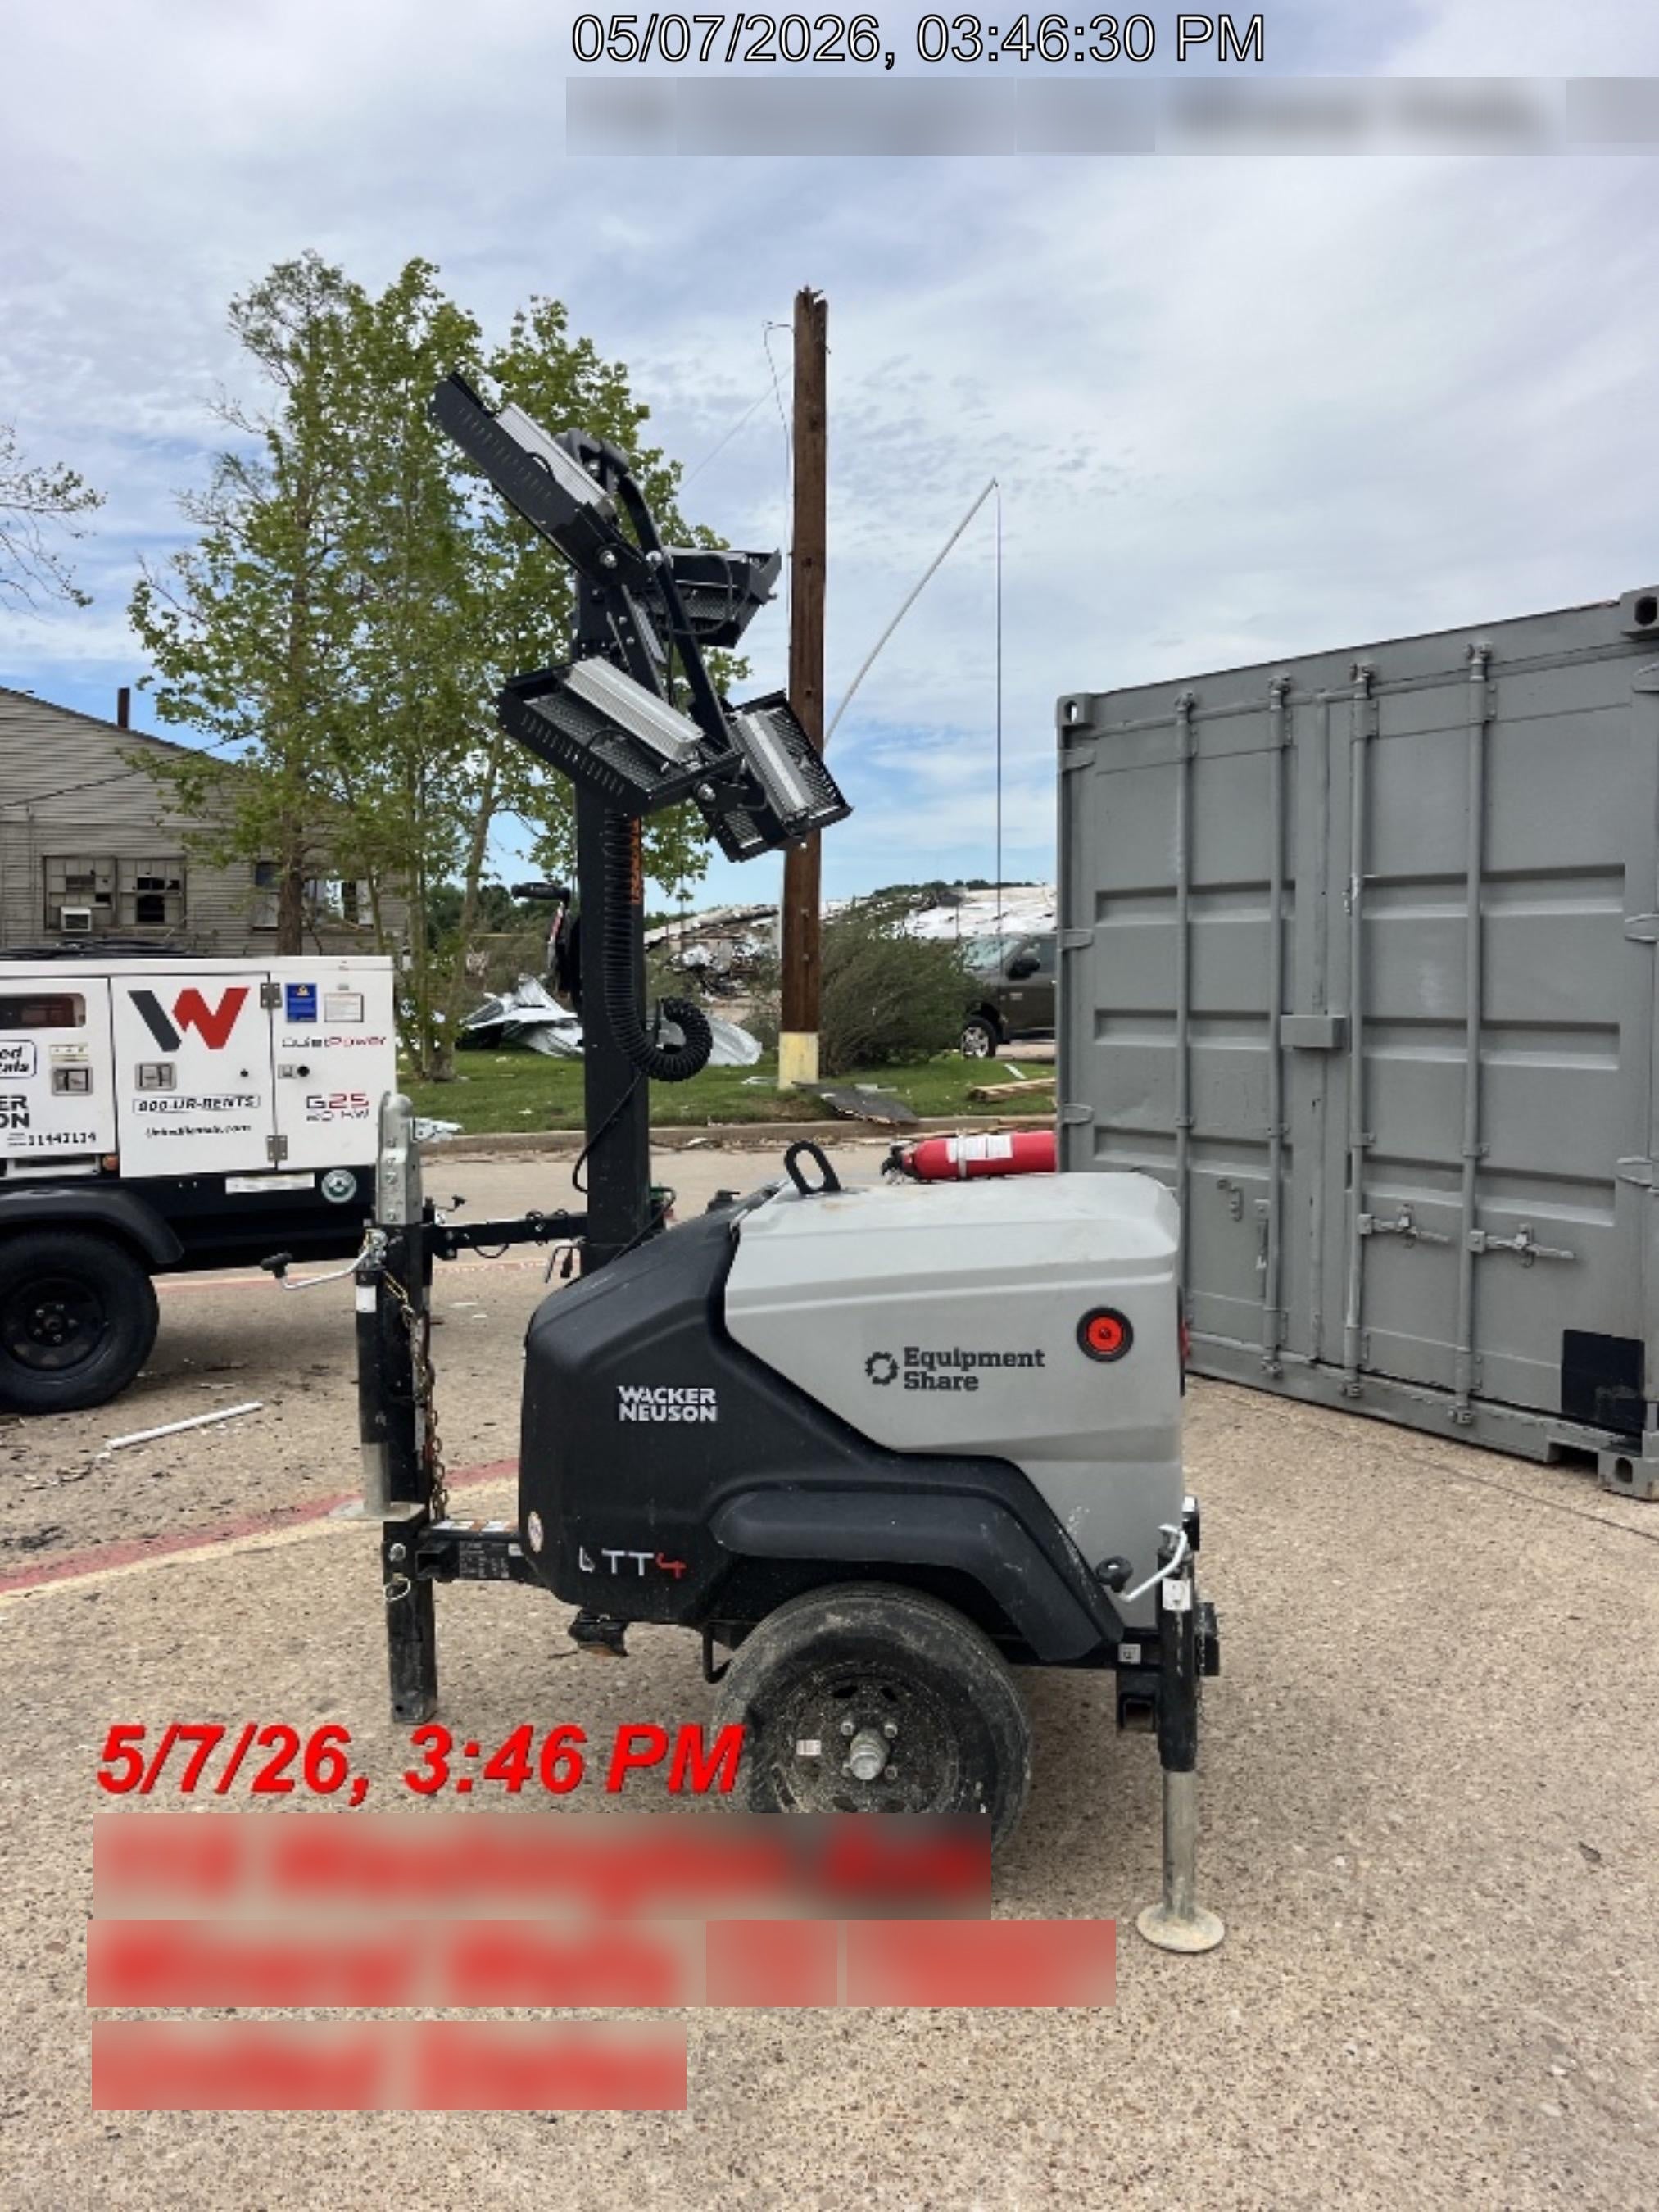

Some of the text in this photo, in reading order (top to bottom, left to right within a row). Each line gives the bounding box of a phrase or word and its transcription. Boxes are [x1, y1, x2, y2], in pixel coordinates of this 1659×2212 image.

[306, 1093, 369, 1109] G25
[904, 1347, 1045, 1371] Equipment
[904, 1371, 979, 1391] Share
[616, 1385, 717, 1404] WACKER
[619, 1404, 718, 1422] NEUSON
